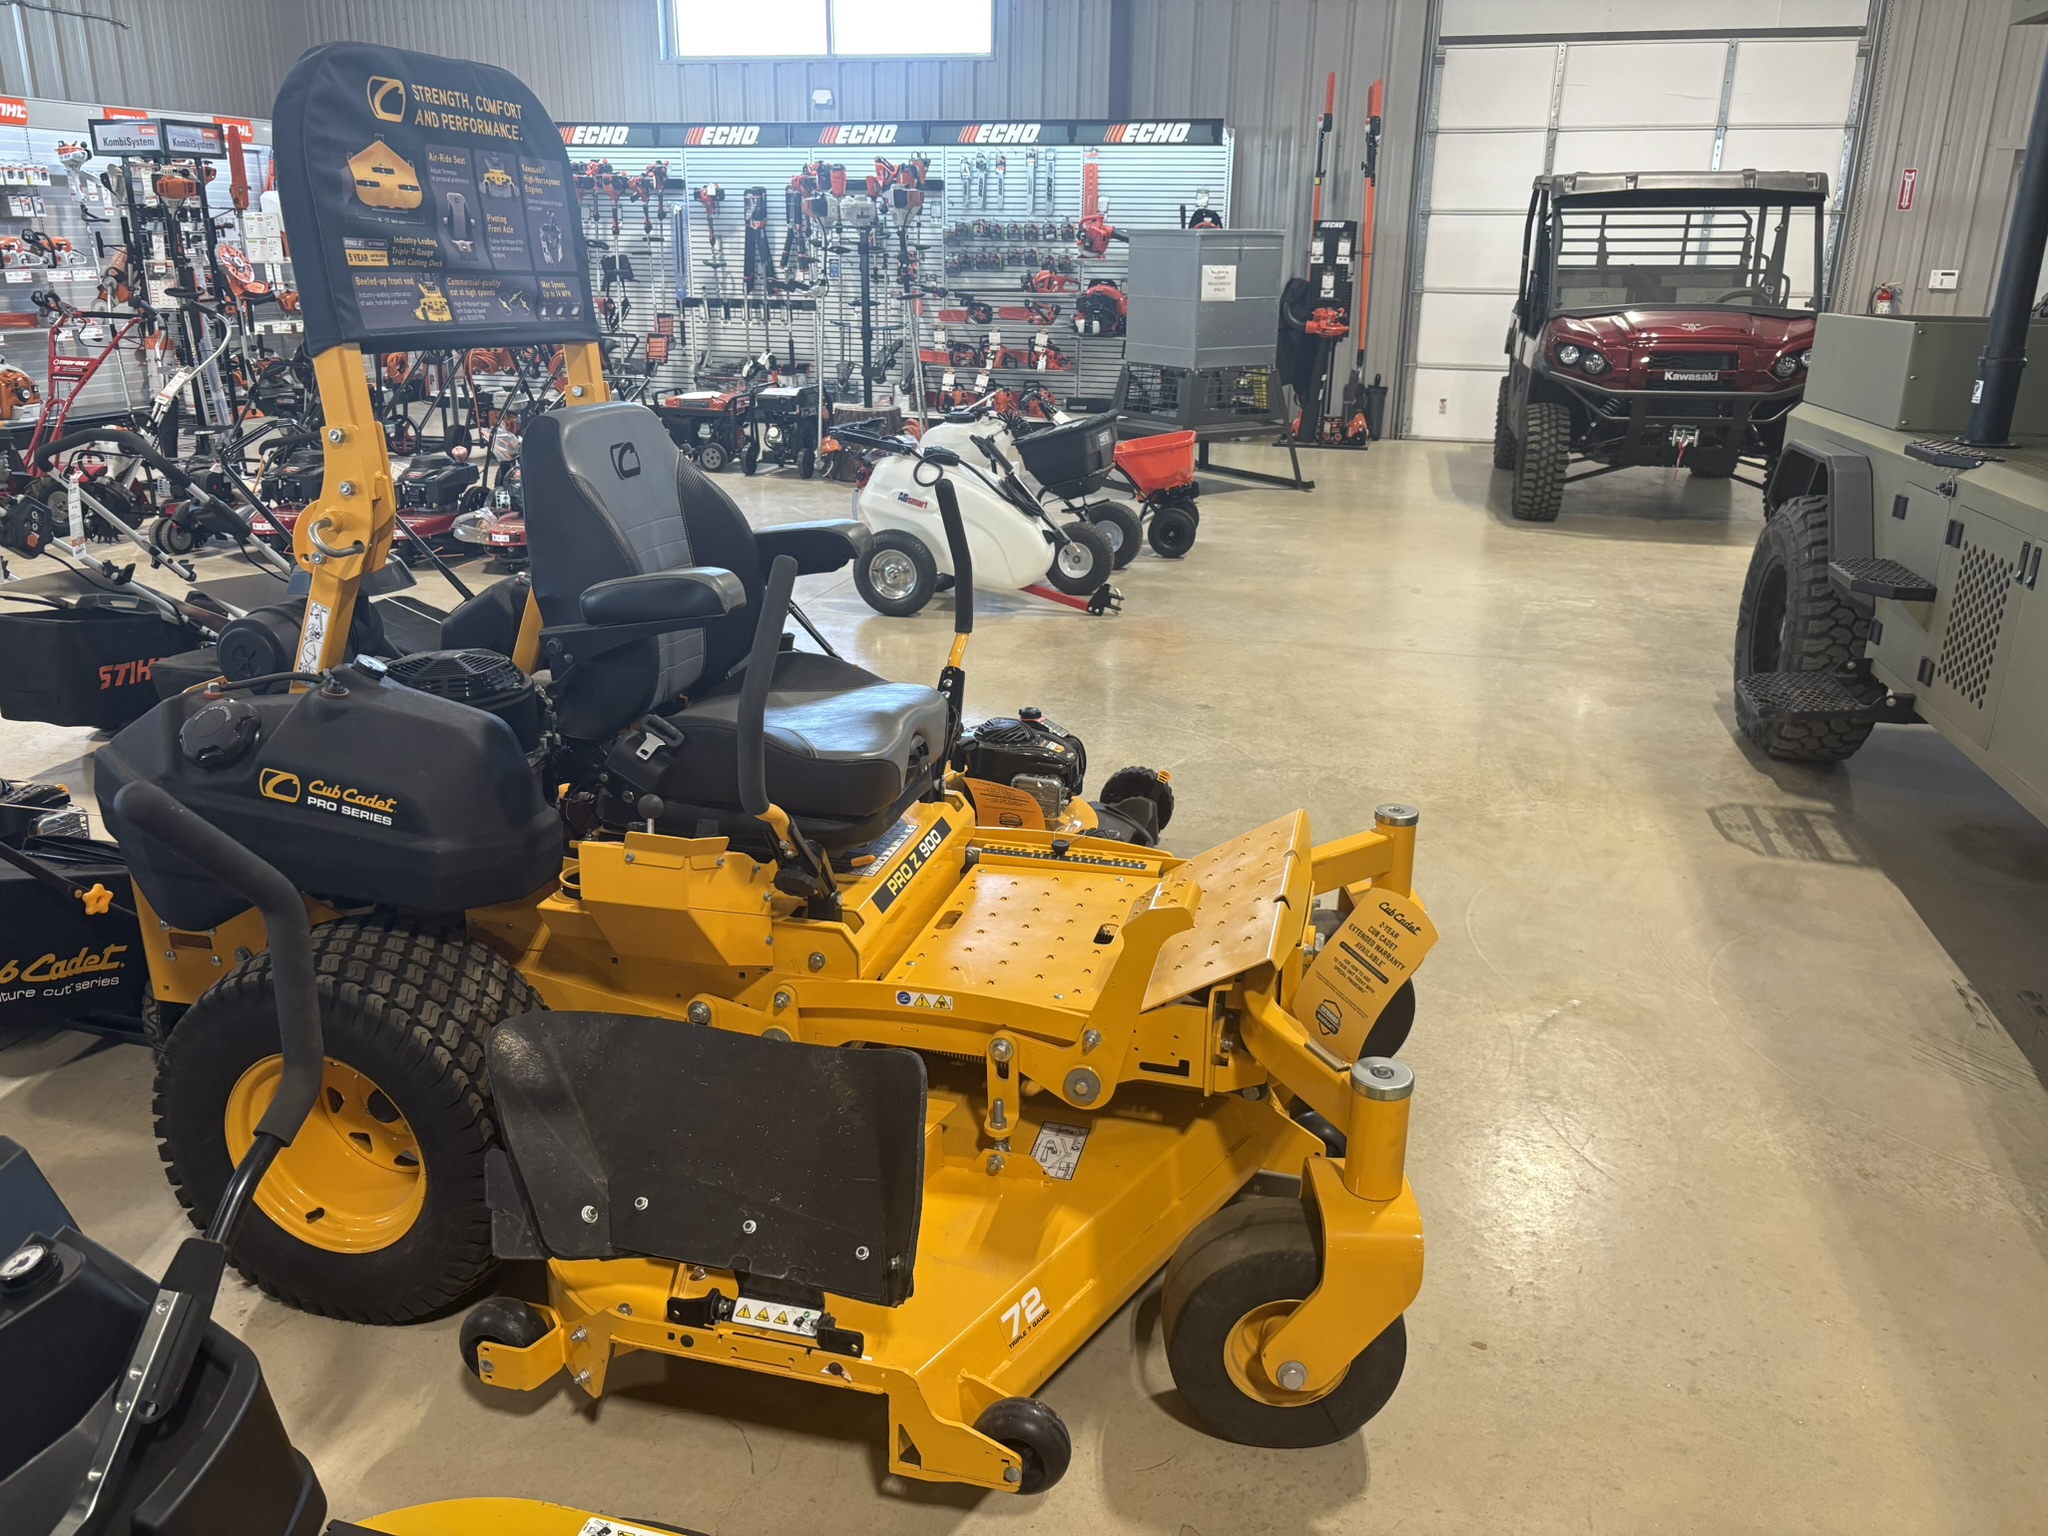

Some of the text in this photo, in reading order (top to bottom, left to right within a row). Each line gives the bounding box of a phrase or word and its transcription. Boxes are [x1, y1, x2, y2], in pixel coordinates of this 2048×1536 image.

[411, 84, 522, 120] STRENGTH, COMFORT
[222, 124, 252, 137] SHL
[414, 109, 524, 141] AND PERFORMANCE.
[835, 124, 898, 144] ECHO
[976, 124, 1041, 143] ECHO
[1121, 123, 1191, 143] ECHO
[103, 137, 154, 148] KombiSystem
[172, 138, 215, 150] KombiSystem
[572, 126, 629, 145] ECHO
[700, 126, 760, 145] ECHO
[429, 152, 465, 164] Air-Ride Seat
[487, 214, 507, 224] Pivoting
[488, 224, 514, 234] Front Axle
[353, 254, 369, 262] YEAR
[392, 246, 434, 257] Triple-7-Gauge
[392, 257, 406, 266] Steel
[407, 258, 427, 267] Cutting
[355, 276, 414, 287] Beefed-up front end
[447, 278, 501, 288] Commercial-quality
[466, 288, 476, 297] high
[478, 288, 495, 297] speeds
[1664, 372, 1718, 381] Kawasaki
[99, 657, 167, 690] STIH
[308, 779, 398, 813] Cub Cadet
[307, 796, 392, 826] PRO SERIES
[886, 829, 942, 896] PRO Z 900
[1378, 902, 1422, 936] Cub Cadet
[1368, 926, 1398, 951] CUB CADET
[1379, 921, 1400, 940] 2-YEAR
[1348, 922, 1376, 948] EXTENDED
[1374, 943, 1406, 971] WARRANTY
[21, 944, 128, 983] Cadet
[0, 989, 36, 1003] ture
[76, 976, 119, 992] series
[1318, 1013, 1336, 1031] WARRANTY
[1320, 1006, 1338, 1024] EXTENDED
[1000, 1286, 1046, 1340] 72
[1008, 1330, 1027, 1349] TRIPLE
[1032, 1308, 1051, 1327] GAUGE
